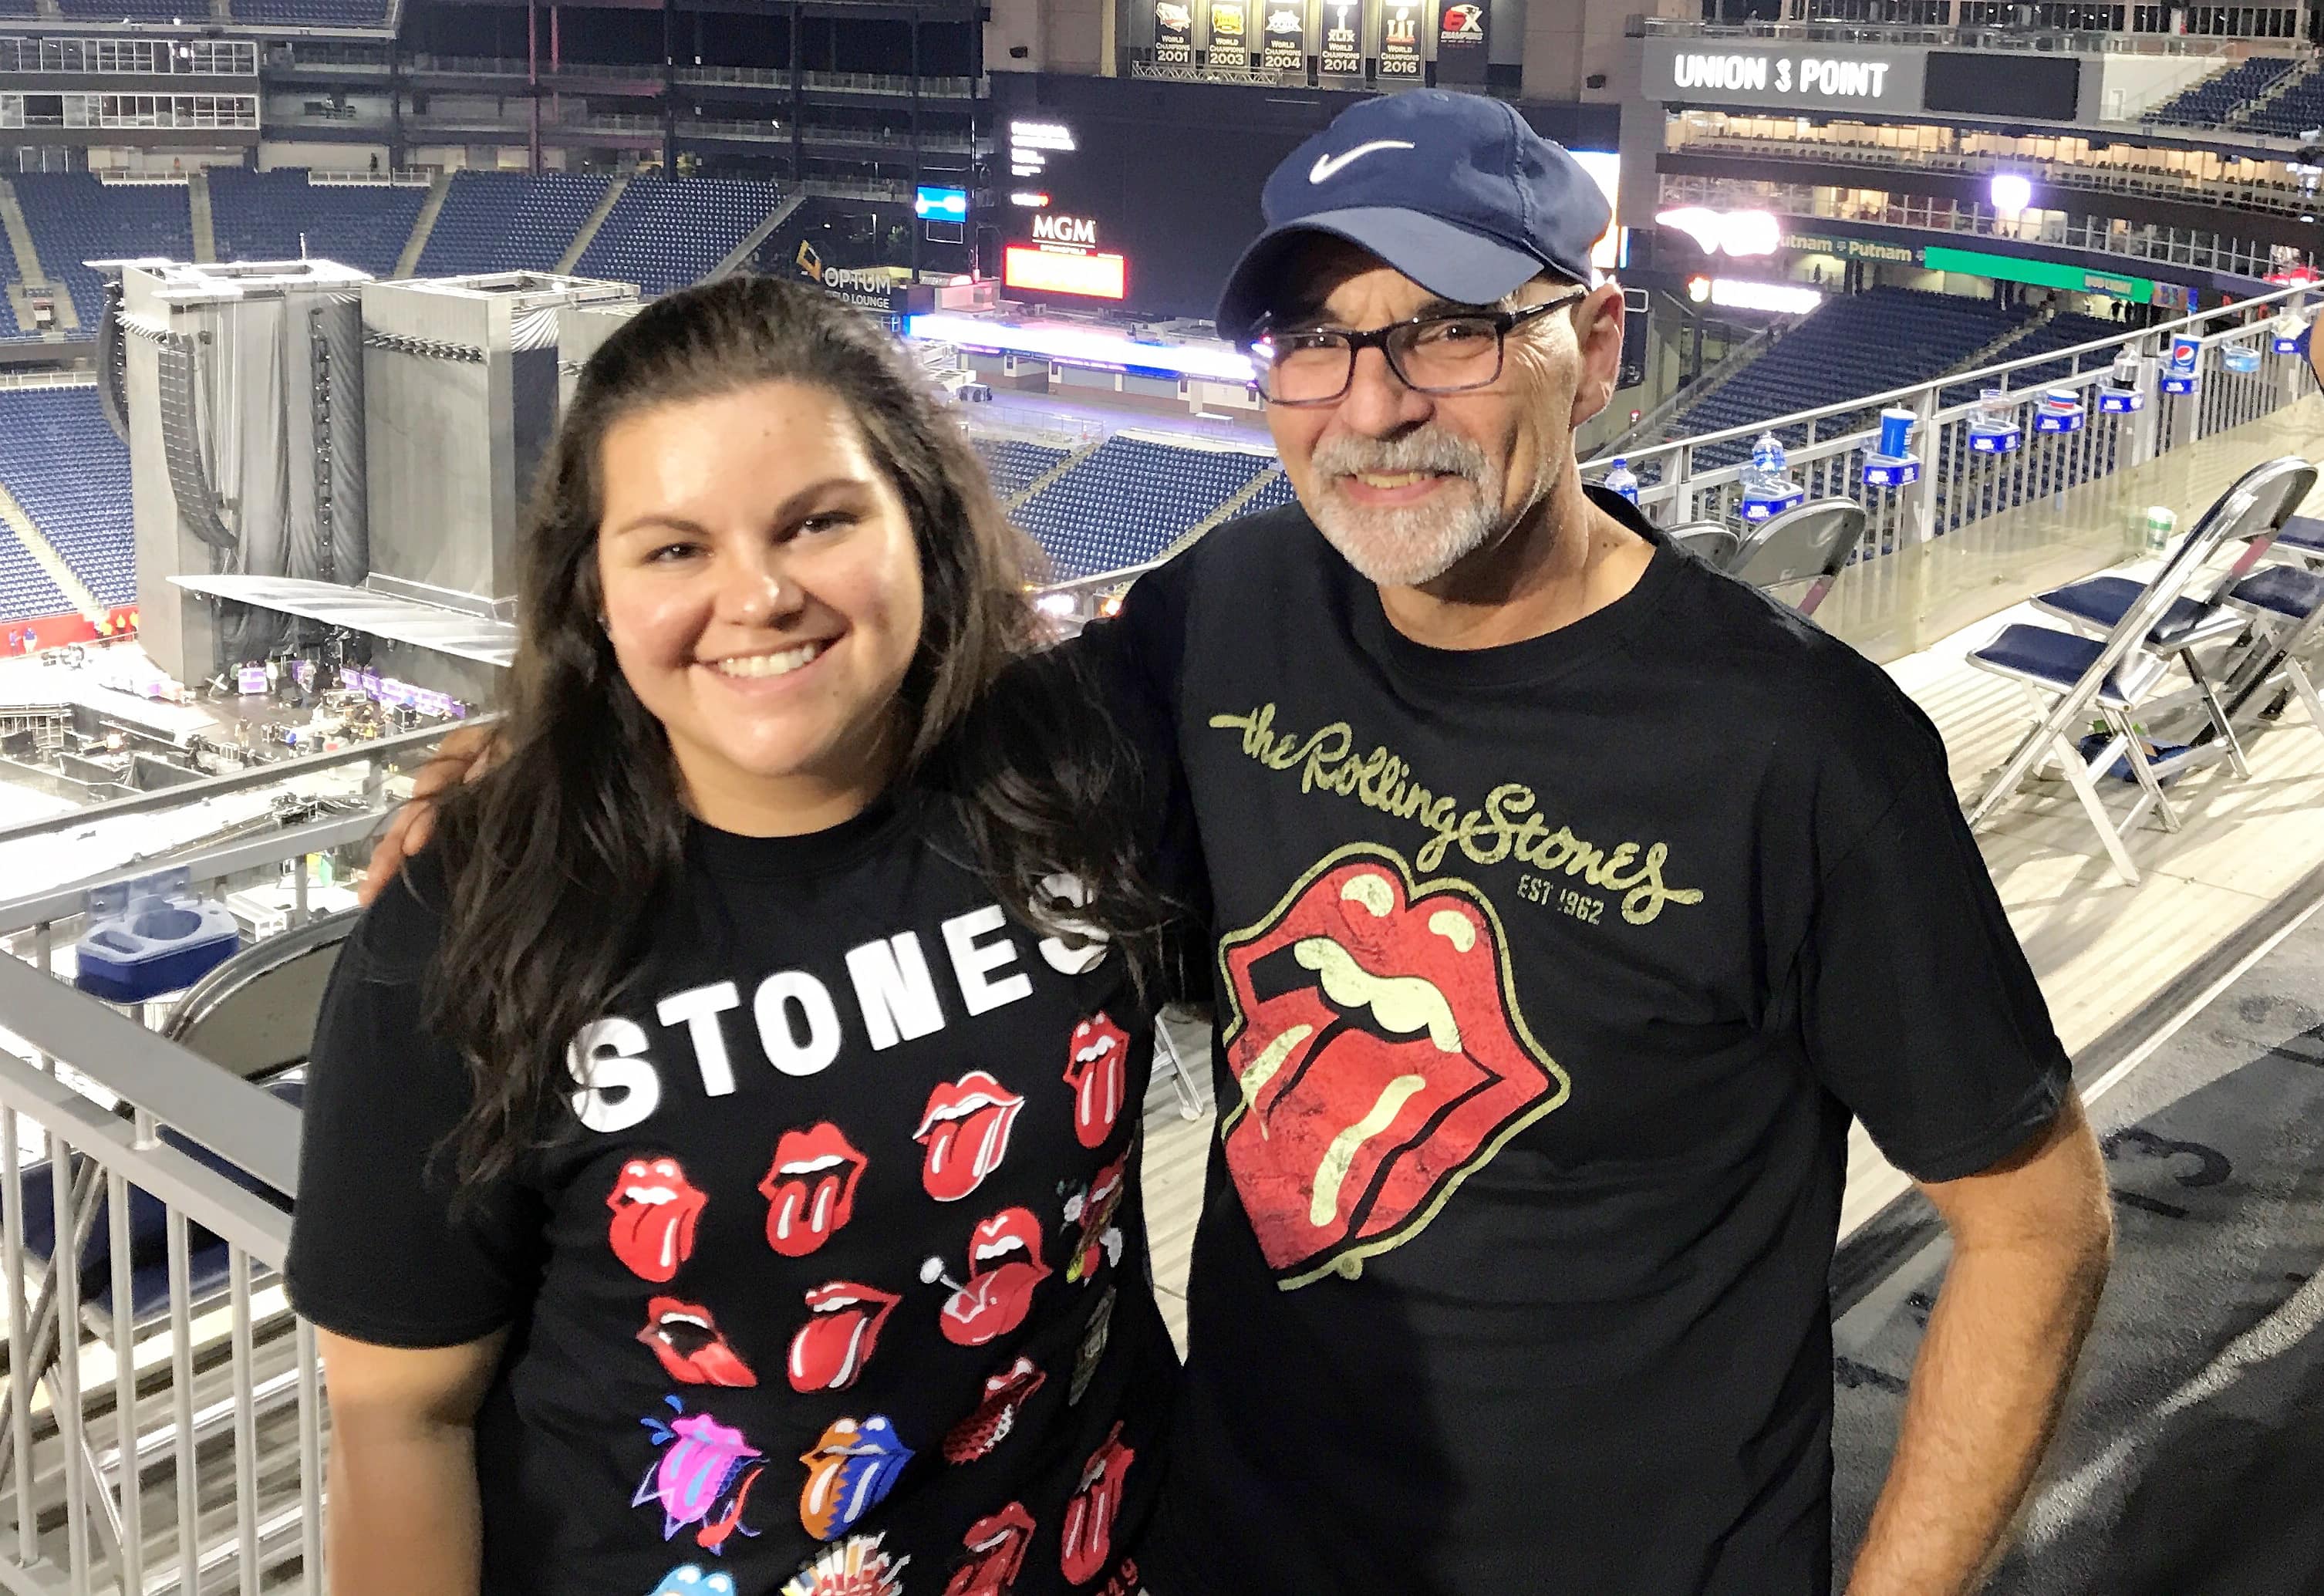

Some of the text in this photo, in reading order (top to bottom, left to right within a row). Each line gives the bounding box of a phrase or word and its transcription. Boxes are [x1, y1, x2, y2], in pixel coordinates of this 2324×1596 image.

[1162, 35, 1184, 44] WORLD
[1271, 40, 1295, 49] WORLD
[1328, 43, 1353, 52] WORLD
[1387, 45, 1412, 53] WORLD
[1157, 51, 1189, 62] 2001
[1209, 52, 1244, 65] 2003
[1265, 56, 1300, 68] 2004
[1324, 59, 1358, 72] 2014
[1383, 61, 1416, 73] 2016
[1675, 54, 1766, 91] UNION
[1799, 59, 1889, 98] POINT
[1032, 214, 1096, 243] MGM
[1781, 235, 1912, 262] utnam Putnam
[825, 267, 891, 295] OPTUM
[851, 293, 890, 309] LOUNGE
[1209, 703, 1704, 926] the Rolling Stones
[1516, 872, 1604, 926] EST 1962
[567, 872, 1110, 1133] STONES
